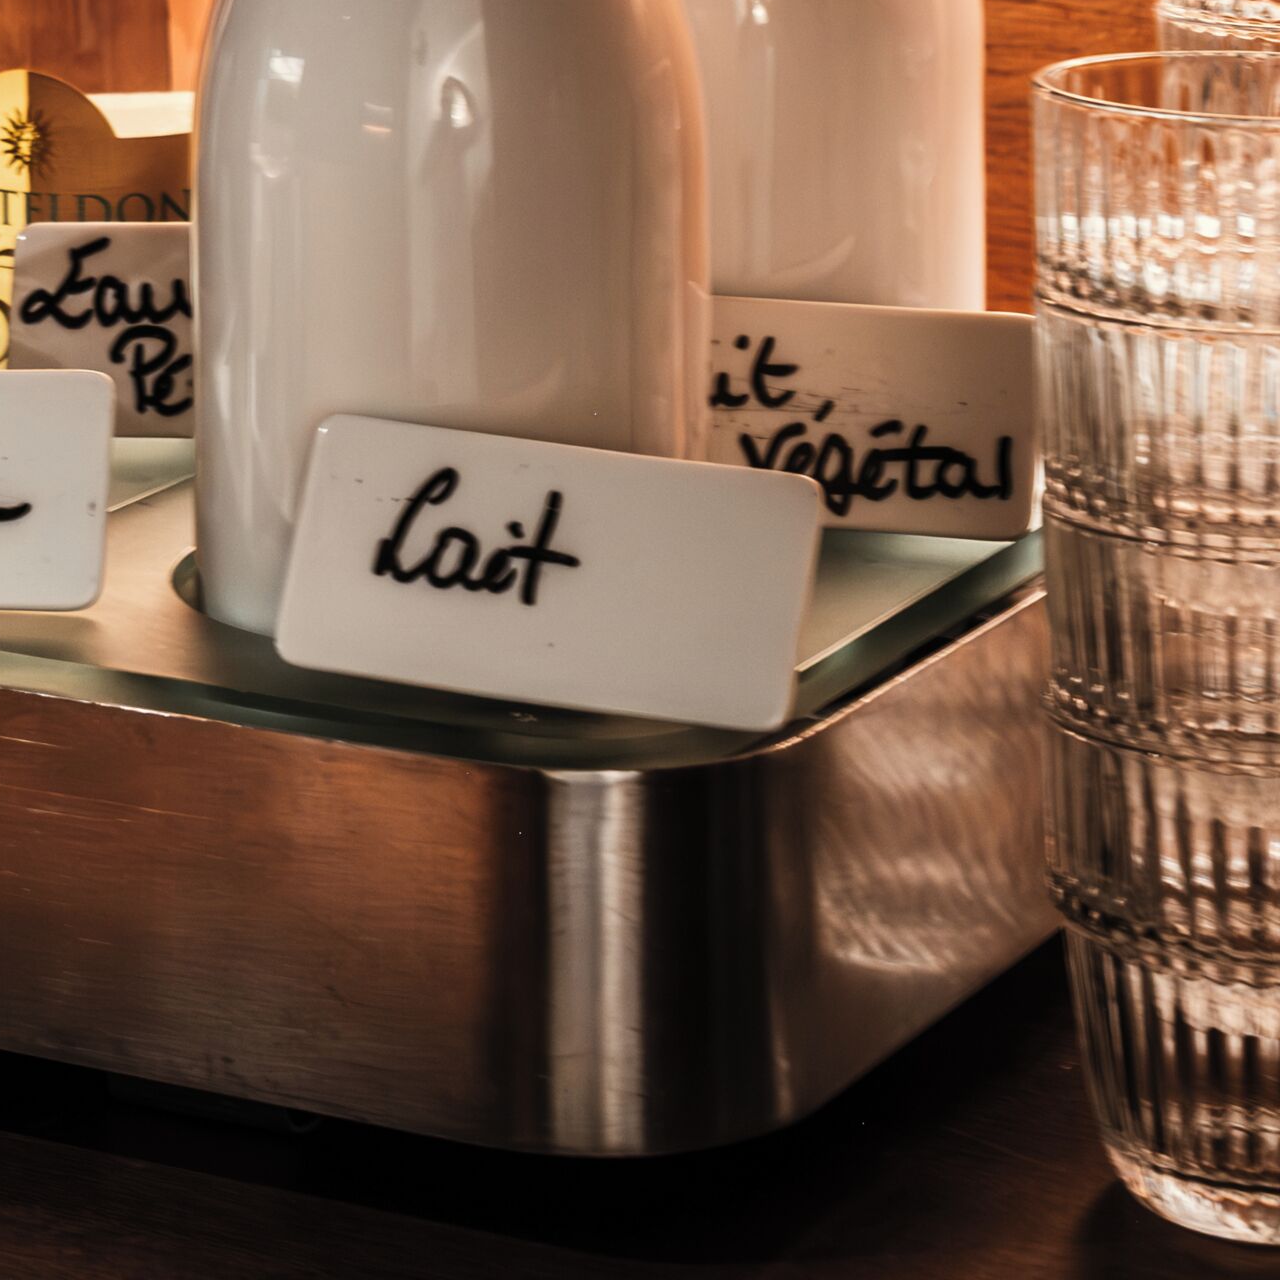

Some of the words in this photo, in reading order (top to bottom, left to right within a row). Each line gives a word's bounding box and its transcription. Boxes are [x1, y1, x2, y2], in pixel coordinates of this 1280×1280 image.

[21, 236, 193, 330] Eau
[708, 334, 801, 409] it
[371, 467, 581, 607] Lait
